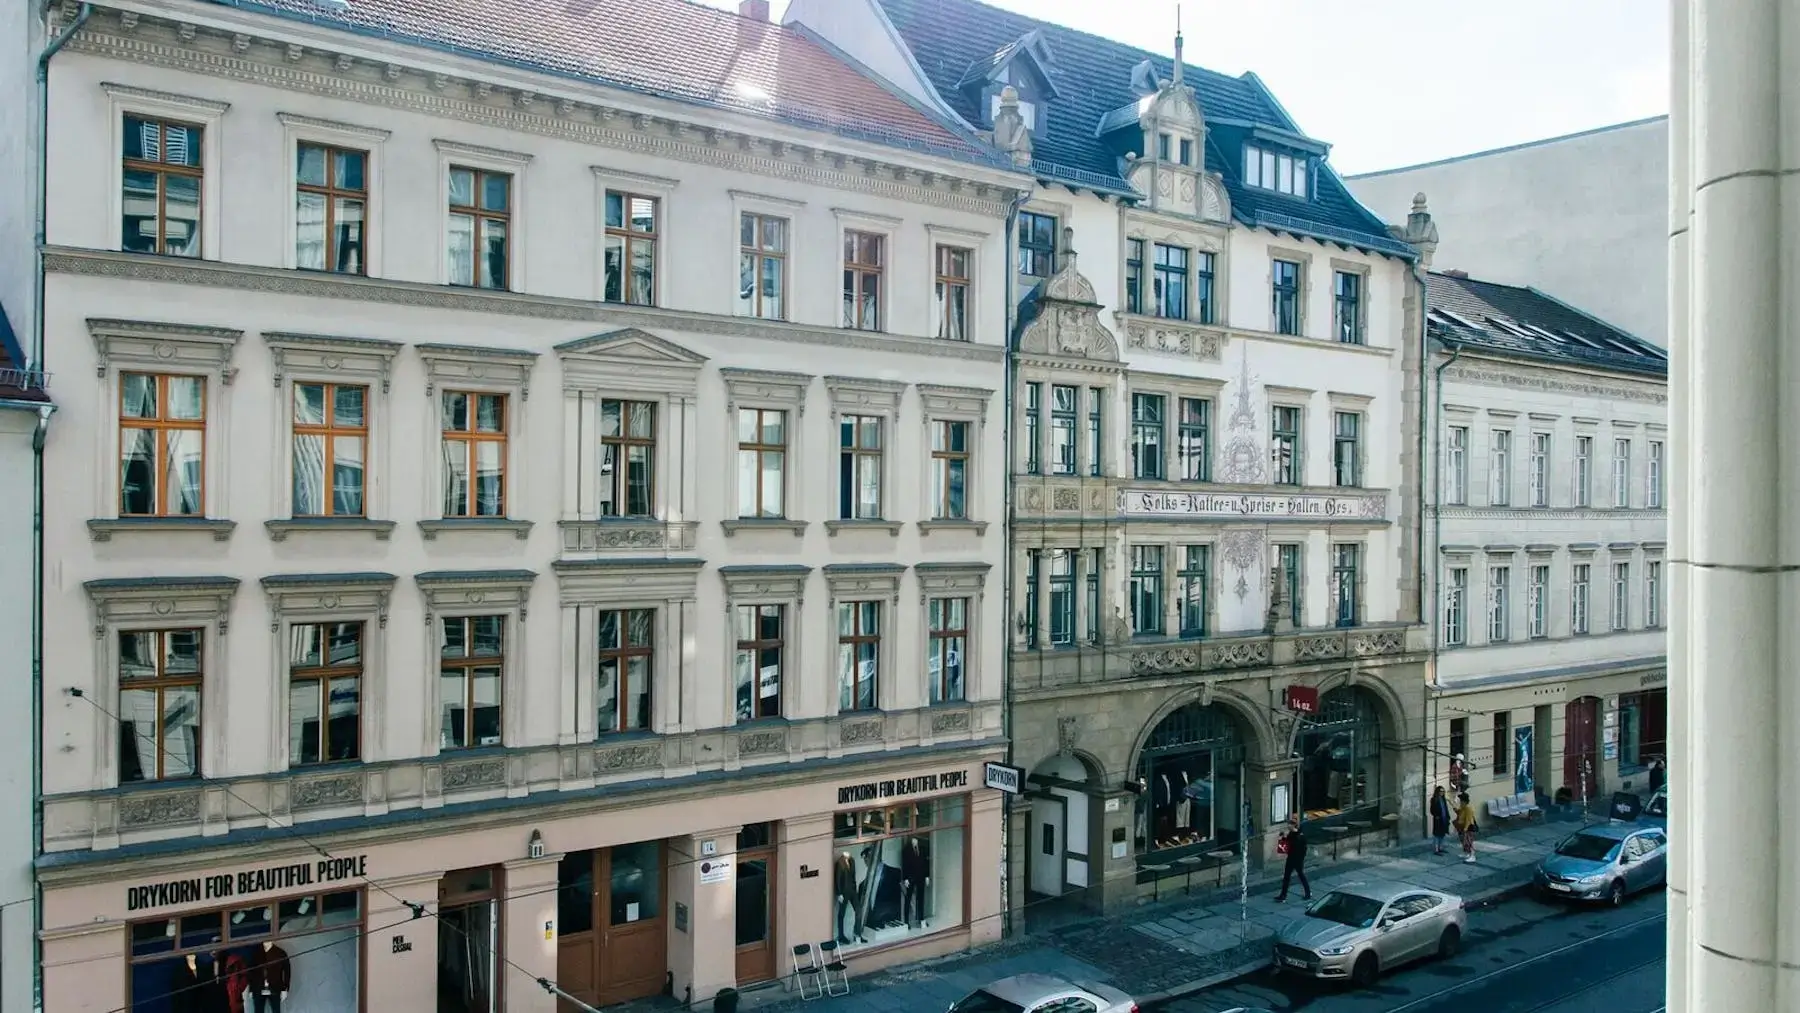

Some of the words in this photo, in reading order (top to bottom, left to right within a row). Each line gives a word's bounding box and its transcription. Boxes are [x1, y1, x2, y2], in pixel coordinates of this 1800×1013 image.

[838, 782, 878, 804] DRYKORN
[879, 780, 895, 797] FOR
[897, 774, 938, 795] BEAUTIFUL
[940, 770, 968, 789] PEOPLE
[988, 767, 1017, 787] DRYKORN
[128, 879, 201, 911] DRYKORN
[205, 874, 234, 899] FOR
[238, 863, 314, 894] BEAUTIFUL
[318, 855, 367, 882] PEOPLE
